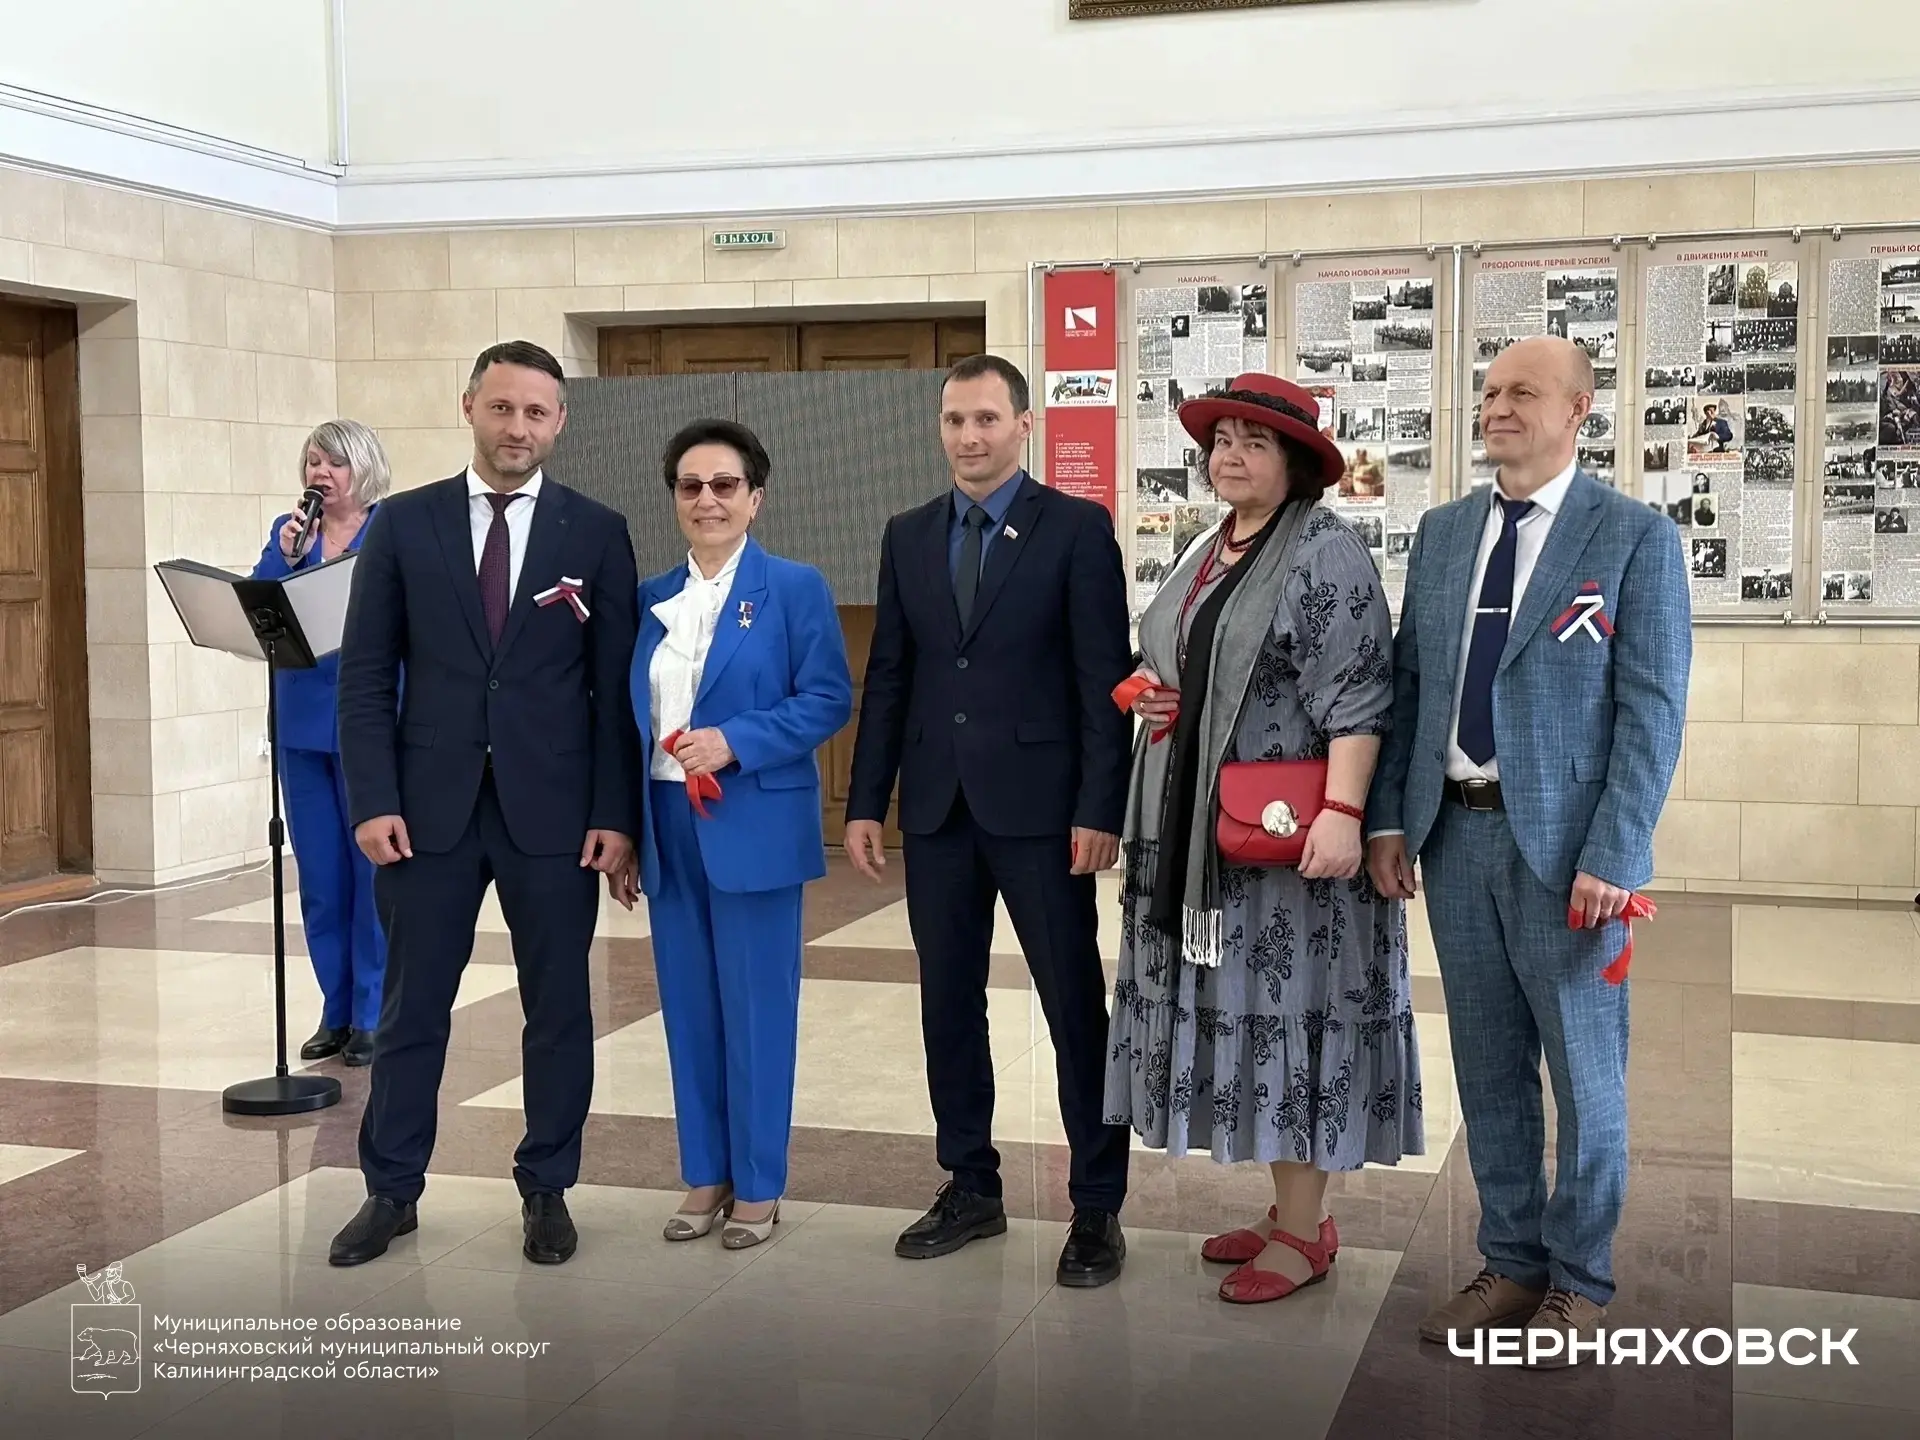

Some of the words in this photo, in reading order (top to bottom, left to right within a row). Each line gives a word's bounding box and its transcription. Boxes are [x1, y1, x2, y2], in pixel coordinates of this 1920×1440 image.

[719, 233, 769, 244] ВЫХОД
[1870, 244, 1906, 254] ПЕРВЫЙ
[1683, 251, 1732, 262] ДВИЖЕНИИ
[1733, 251, 1739, 259] К
[1740, 249, 1769, 259] МЕЧТЕ
[1544, 257, 1577, 267] ПЕРВЫЕ
[1577, 256, 1610, 266] УСПЕХИ
[1318, 269, 1350, 279] НАЧАЛО
[1351, 267, 1380, 277] НОВОЙ
[1381, 267, 1410, 276] ЖИЗНИ
